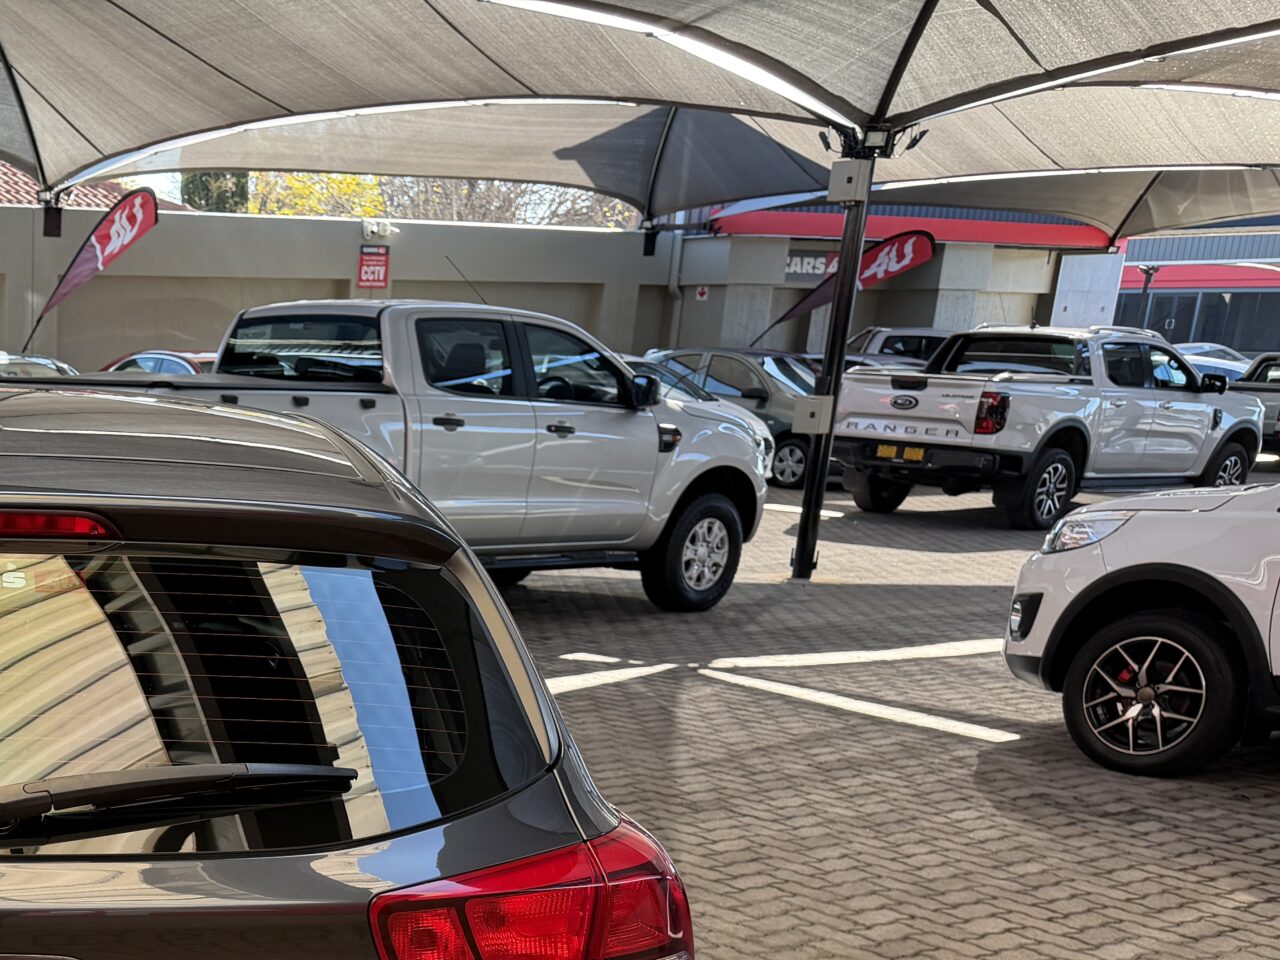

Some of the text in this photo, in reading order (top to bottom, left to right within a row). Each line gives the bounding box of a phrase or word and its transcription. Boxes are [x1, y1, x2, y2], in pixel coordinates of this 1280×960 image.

[860, 236, 917, 279] 4U
[361, 265, 386, 281] CCTV
[846, 421, 960, 438] RANGER
